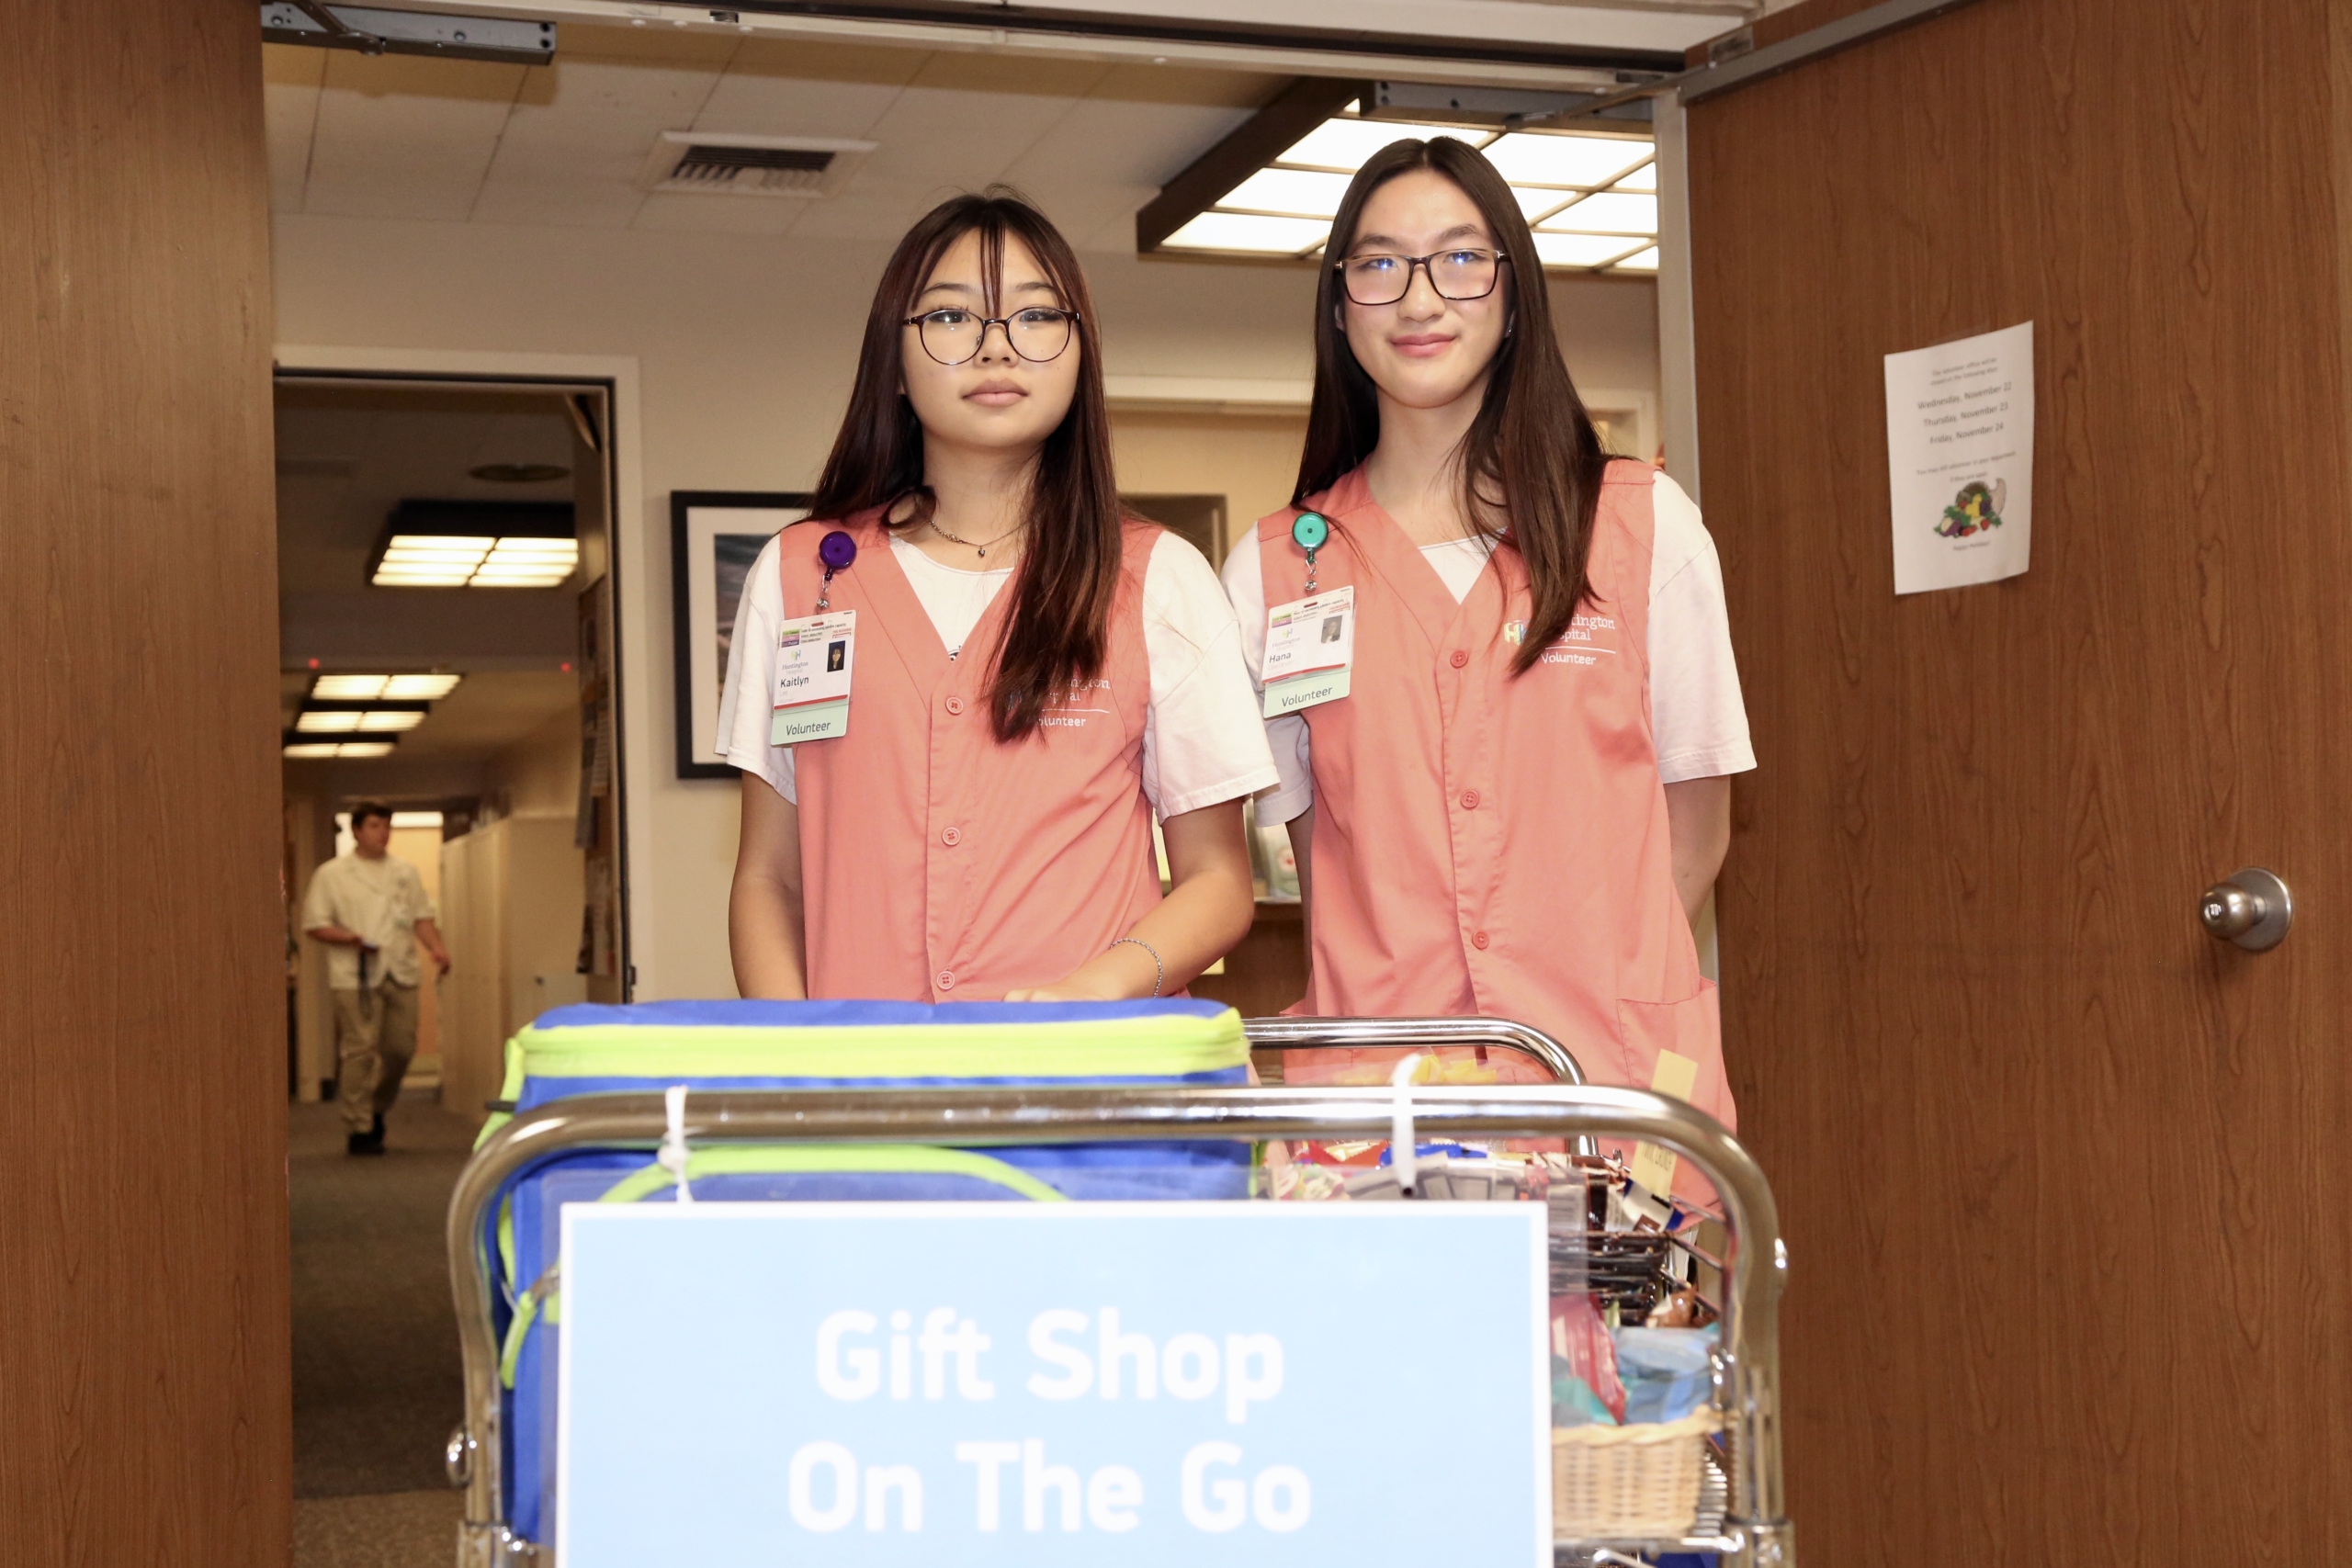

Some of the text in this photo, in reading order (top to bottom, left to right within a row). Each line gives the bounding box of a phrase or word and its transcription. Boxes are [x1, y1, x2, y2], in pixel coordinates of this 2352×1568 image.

[1917, 381, 2012, 410] Wednesday, November 22
[1923, 412, 1959, 428] Thursday,
[1961, 404, 1998, 420] November
[1929, 422, 2005, 445] Friday, November 24
[1571, 614, 1615, 629] tington
[1269, 652, 1291, 664] Hana
[1541, 651, 1596, 666] Volunteer
[780, 675, 808, 688] Kaitlyn
[1282, 686, 1333, 707] Volunteer
[786, 721, 831, 736] Volunteer
[816, 1306, 1285, 1421] Gift Shop
[788, 1439, 1312, 1533] On The Go
